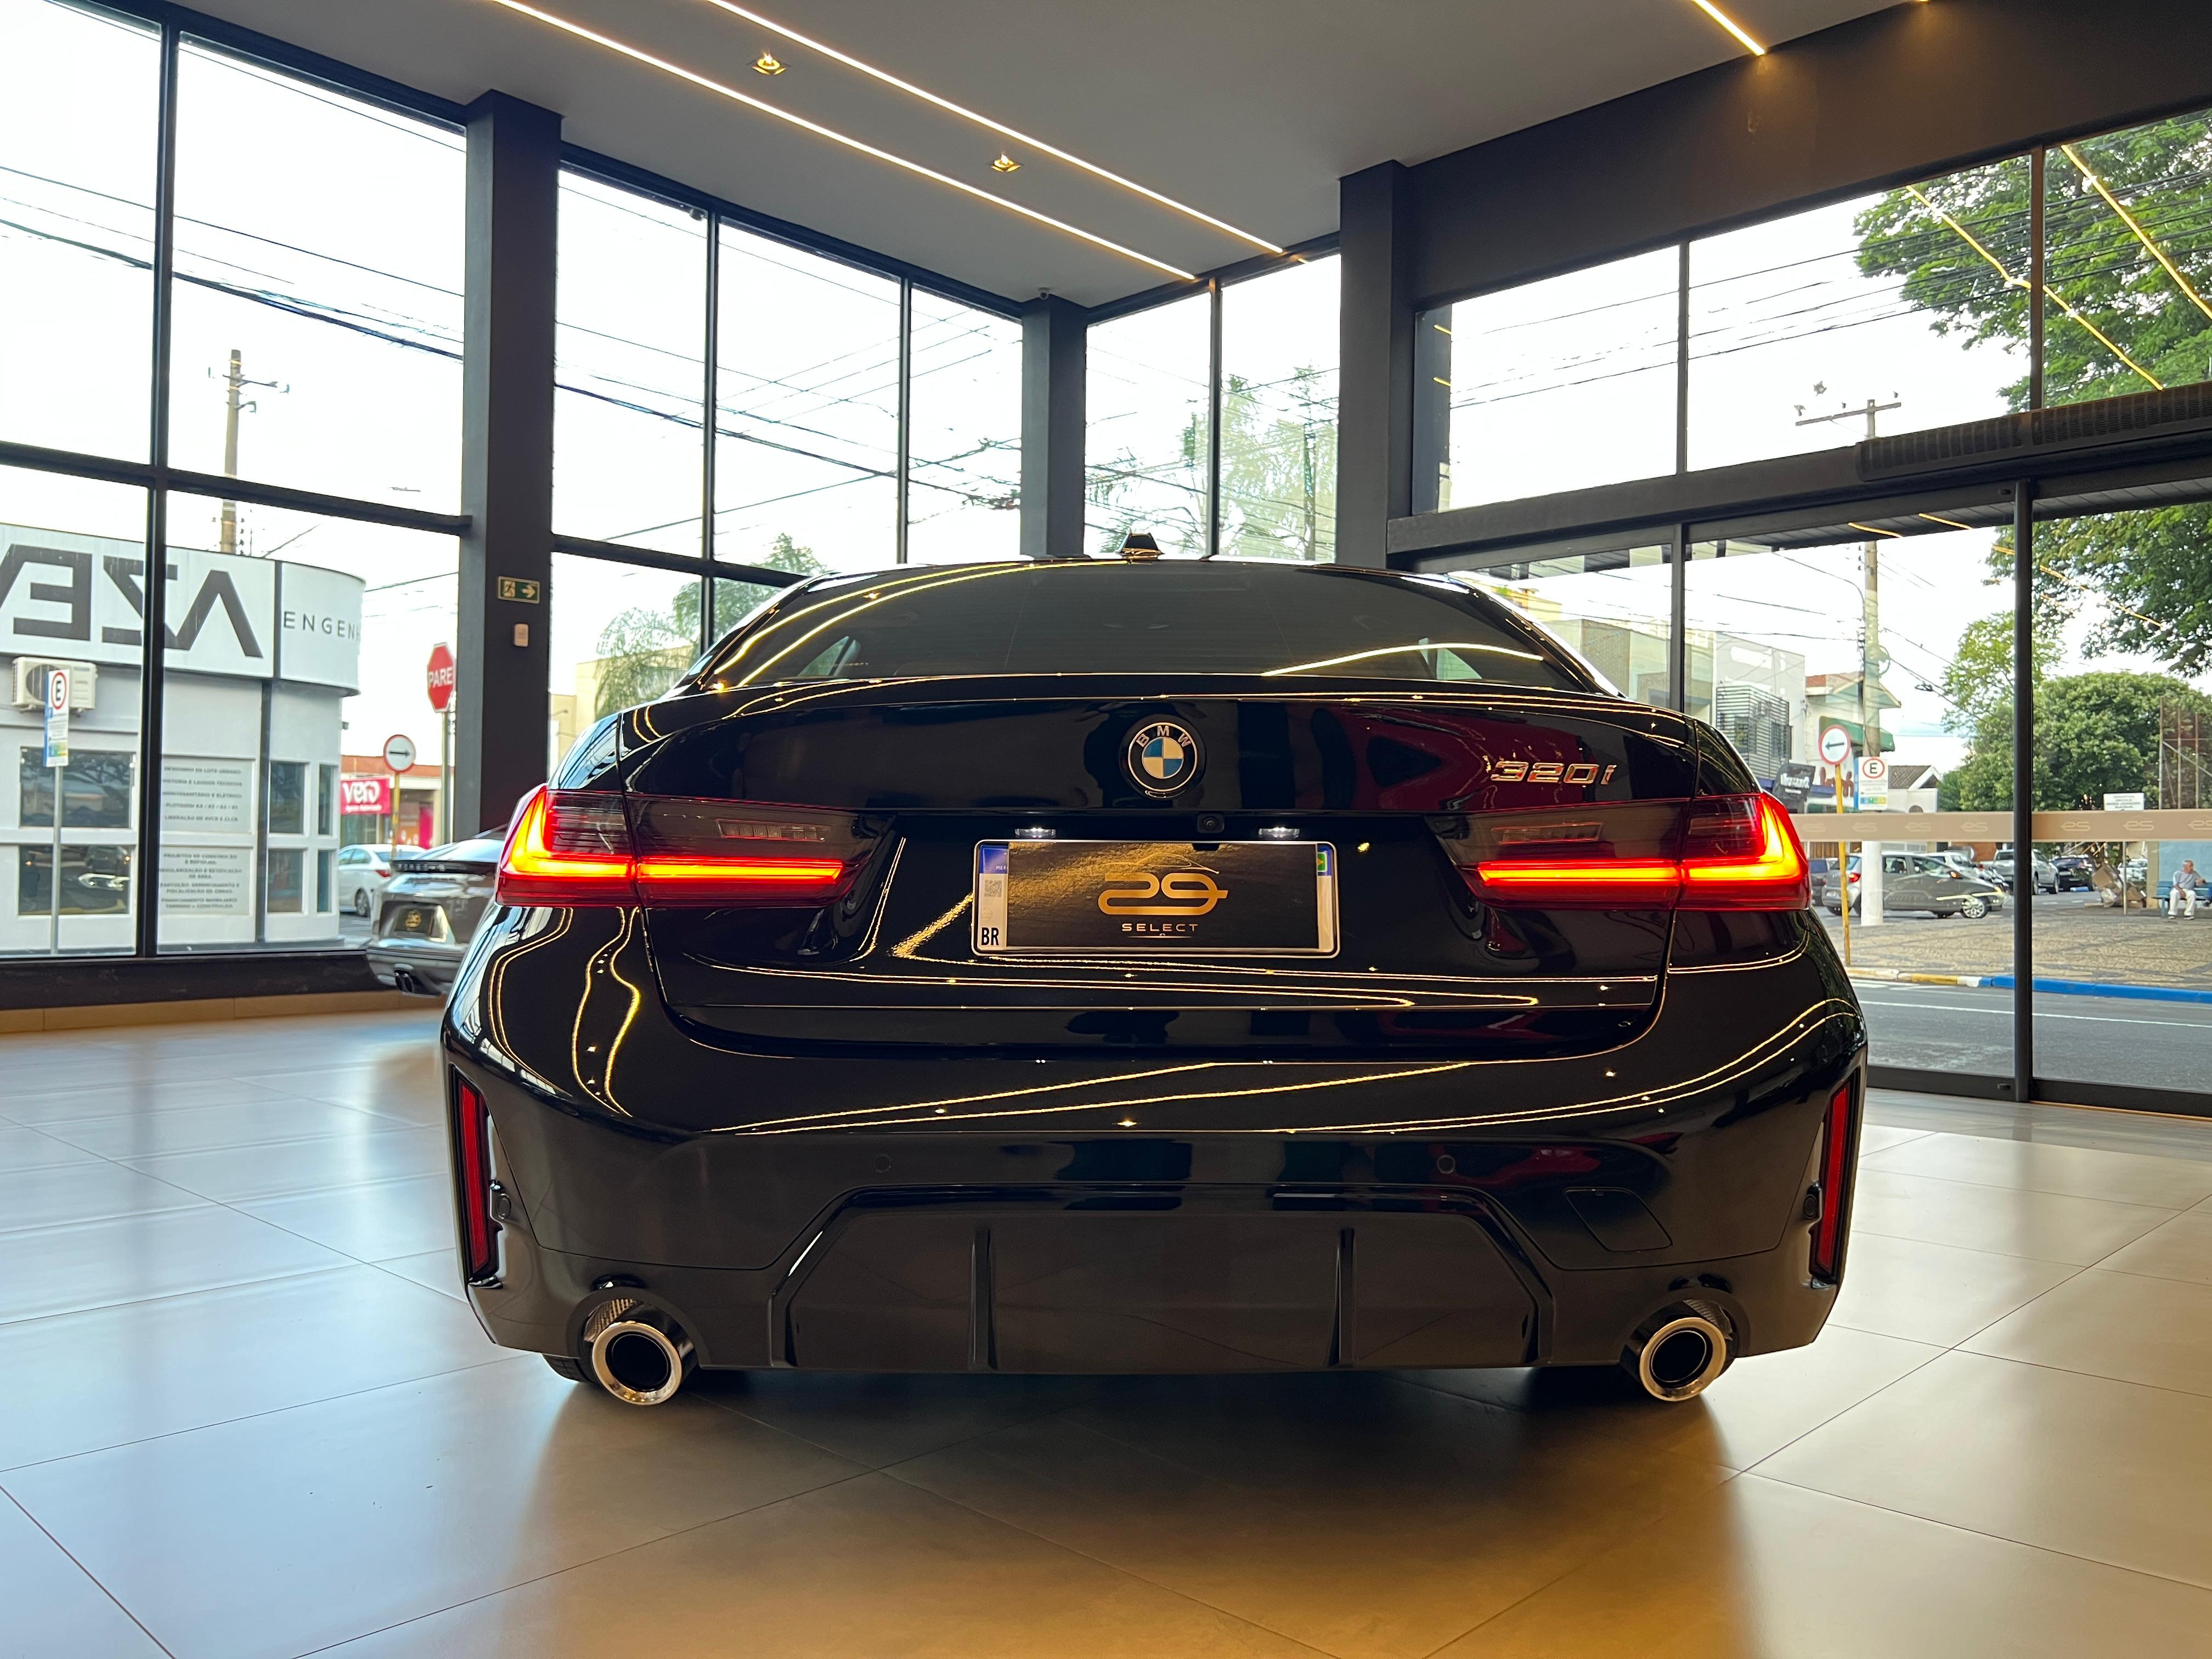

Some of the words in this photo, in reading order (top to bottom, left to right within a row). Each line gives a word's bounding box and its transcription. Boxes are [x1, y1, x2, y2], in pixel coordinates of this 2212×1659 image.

[428, 666, 453, 688] PARE
[55, 679, 61, 701] E
[1136, 725, 1191, 747] BMW
[1490, 760, 1617, 785] 320i
[1870, 762, 1877, 774] E
[981, 927, 999, 946] BR
[1122, 923, 1198, 932] SELECT
